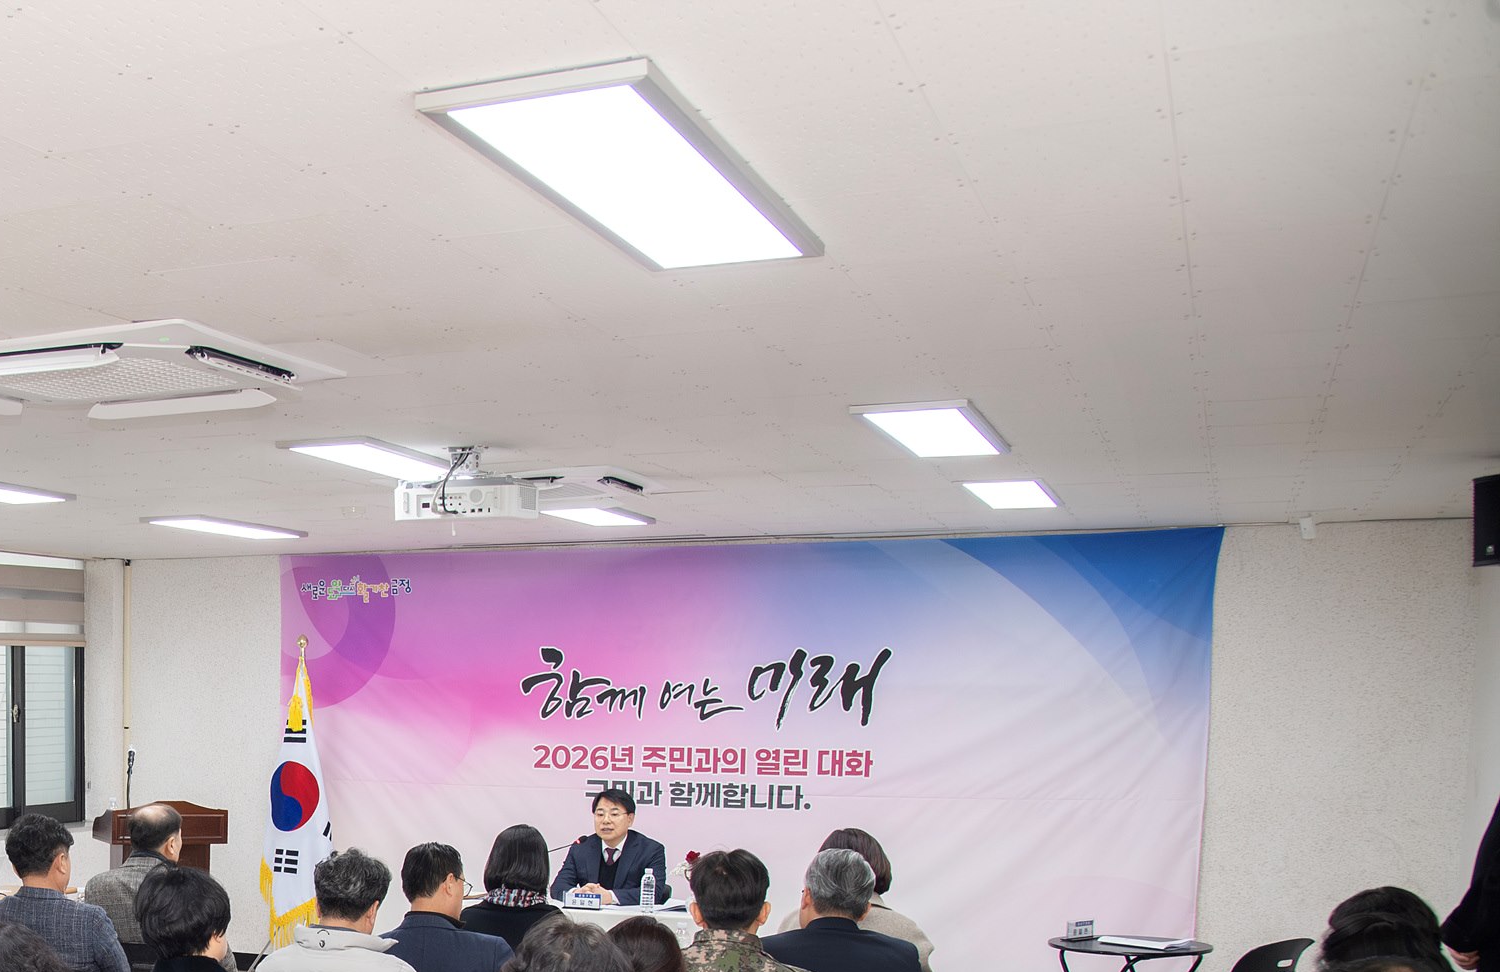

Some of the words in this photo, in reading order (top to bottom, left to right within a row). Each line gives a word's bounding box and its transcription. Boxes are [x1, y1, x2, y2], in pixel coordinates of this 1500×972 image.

[391, 579, 411, 595] 금정
[522, 648, 647, 719] 함께
[659, 679, 744, 720] 여는
[748, 648, 892, 729] 미래
[533, 745, 634, 772] 2026년
[642, 747, 746, 775] 주민과의
[755, 749, 808, 776] 열린
[817, 750, 873, 778] 대화
[669, 781, 812, 811] 함께합니다.
